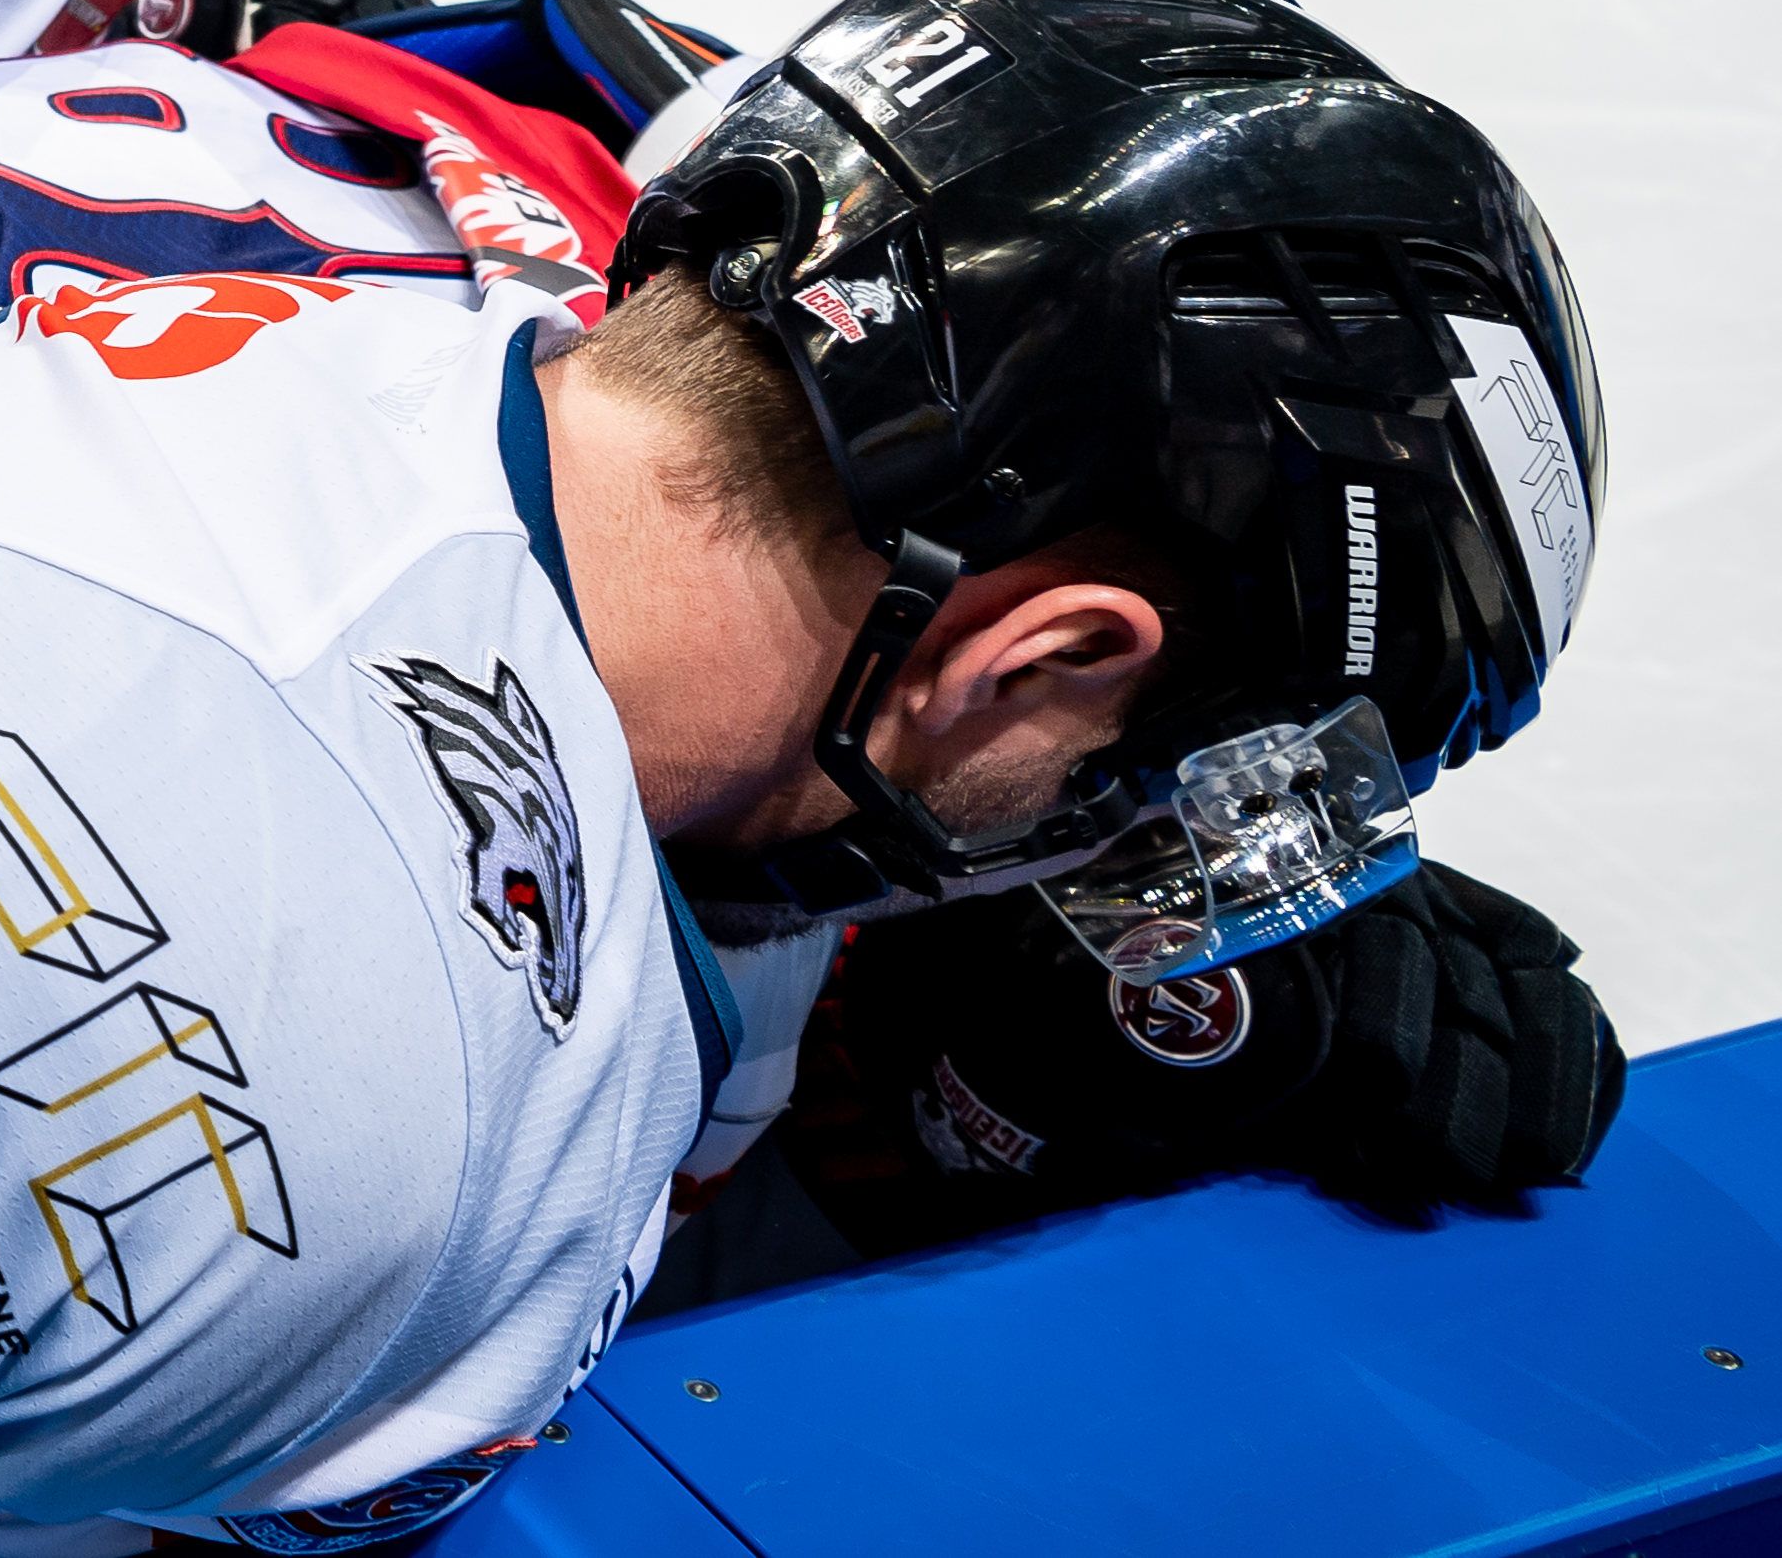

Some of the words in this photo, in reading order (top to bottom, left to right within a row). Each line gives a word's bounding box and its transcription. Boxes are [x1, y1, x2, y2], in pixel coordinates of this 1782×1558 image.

[864, 17, 991, 109] 21
[798, 284, 864, 344] ICETIGERS
[1340, 483, 1377, 679] WARRIOR
